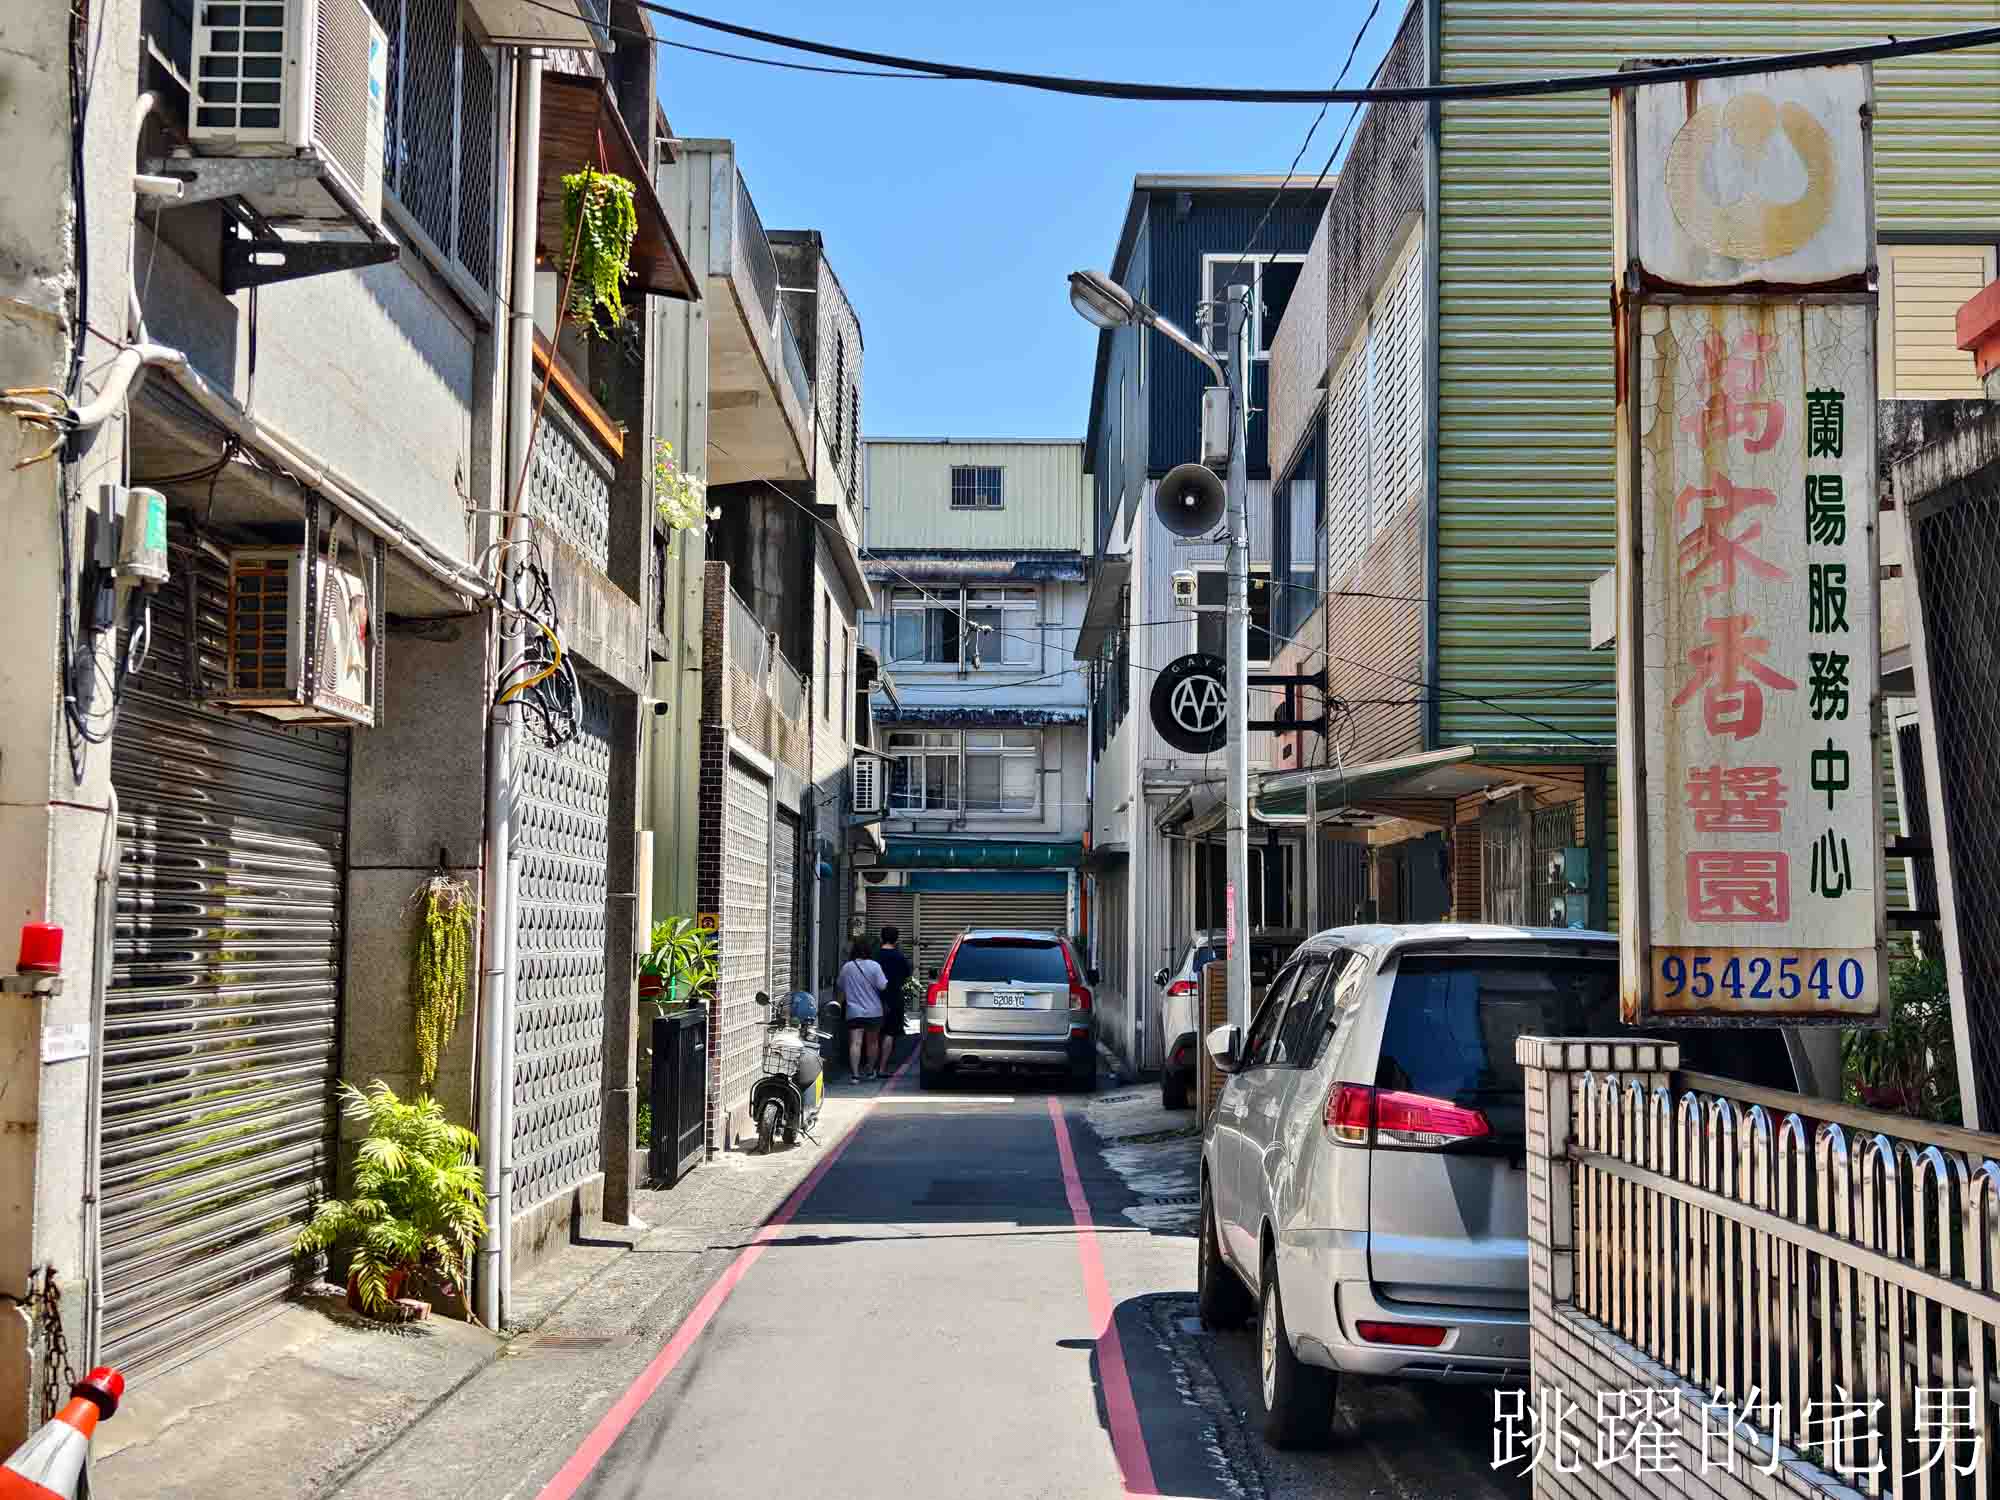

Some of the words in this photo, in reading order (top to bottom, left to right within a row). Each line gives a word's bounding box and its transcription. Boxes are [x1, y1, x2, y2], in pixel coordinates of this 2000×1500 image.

[1805, 388, 1852, 899] 蘭陽服務中心
[1661, 956, 1864, 999] 9542540
